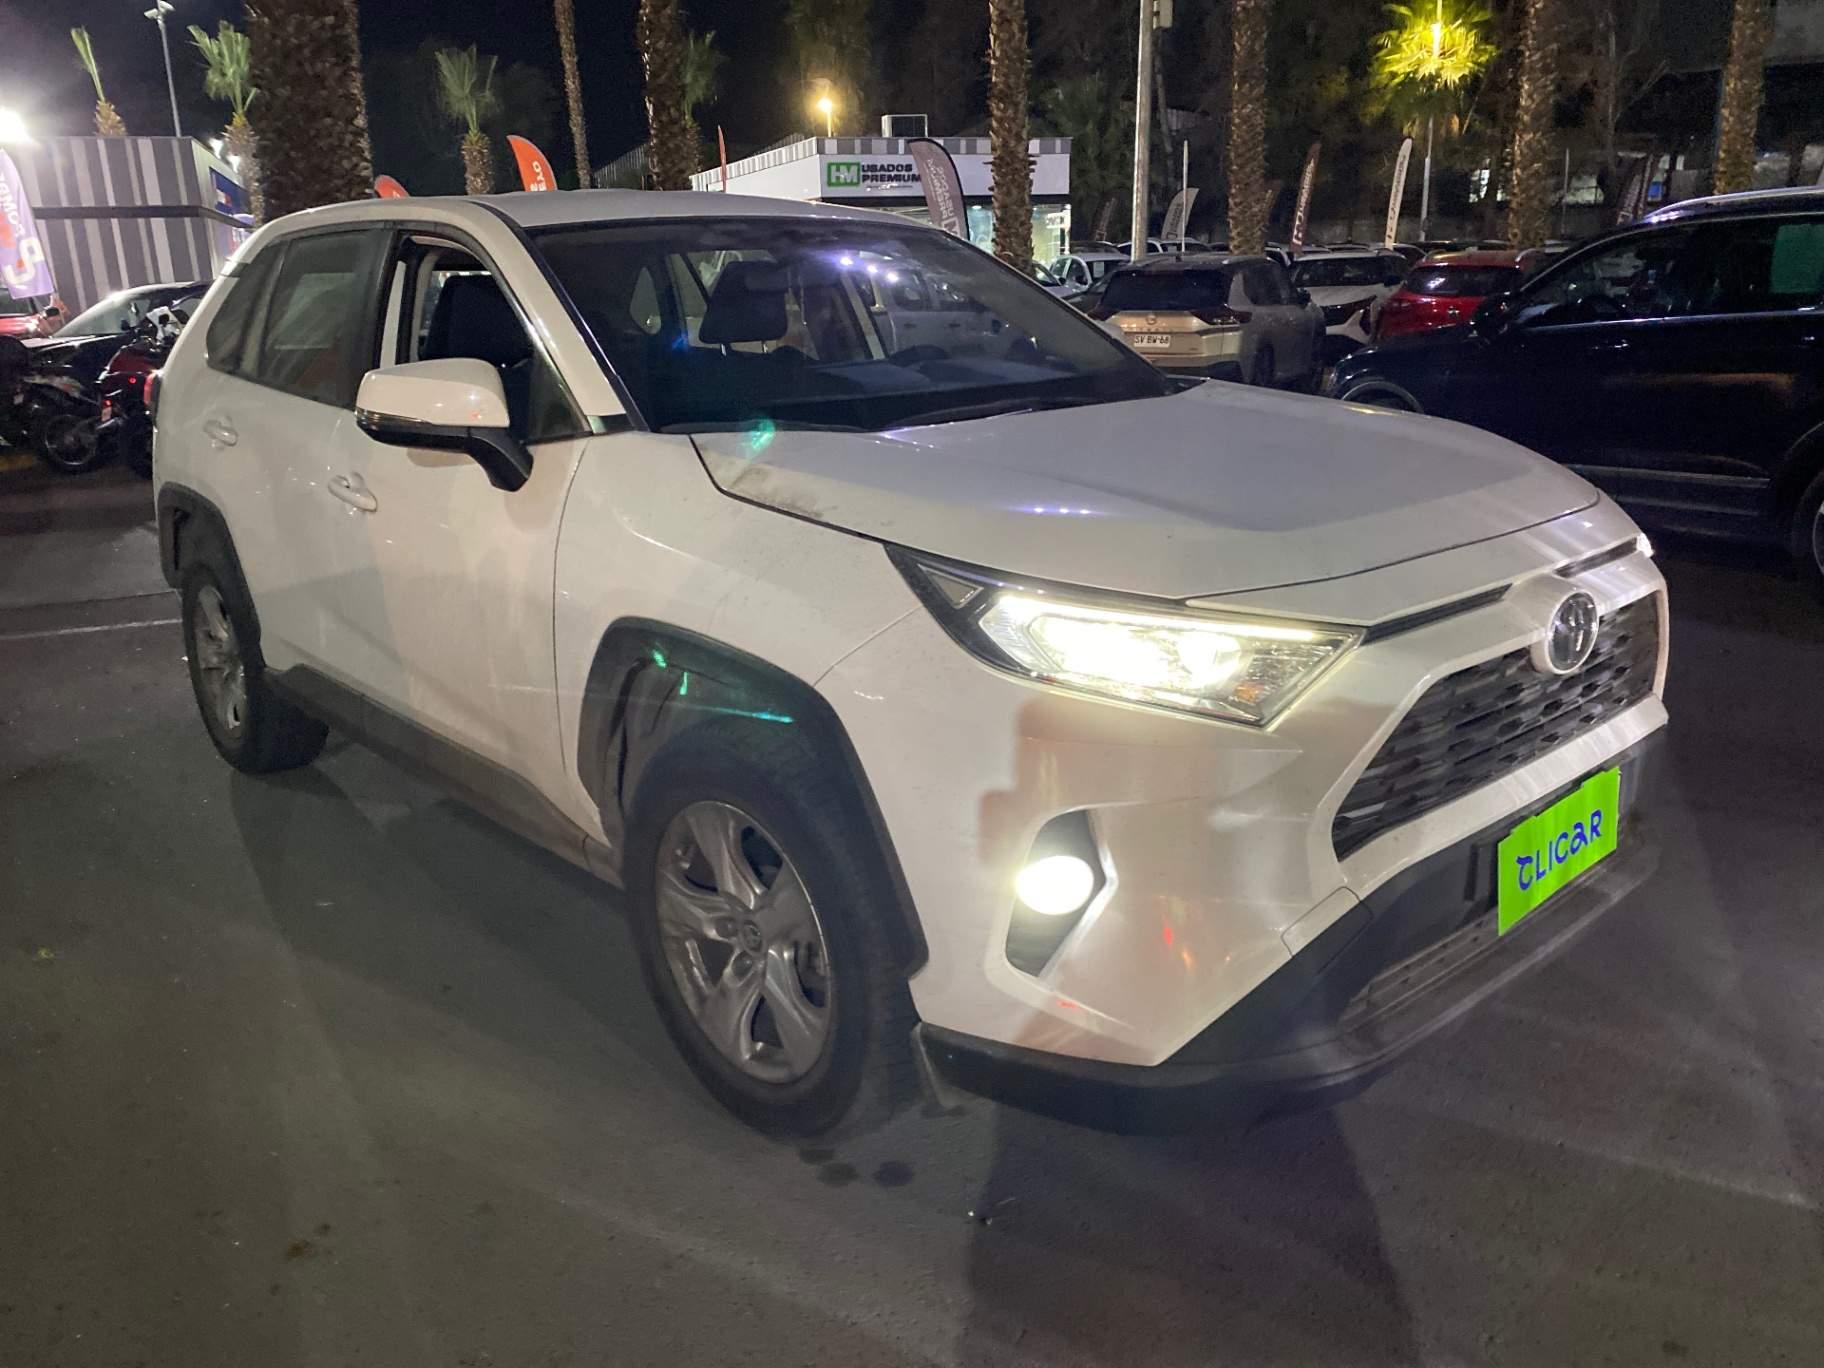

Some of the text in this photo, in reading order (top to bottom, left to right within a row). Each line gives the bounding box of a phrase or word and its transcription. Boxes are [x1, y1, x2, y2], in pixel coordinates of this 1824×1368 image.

[862, 163, 913, 173] USADOS
[830, 164, 859, 184] HM
[862, 173, 921, 183] PREMIUM
